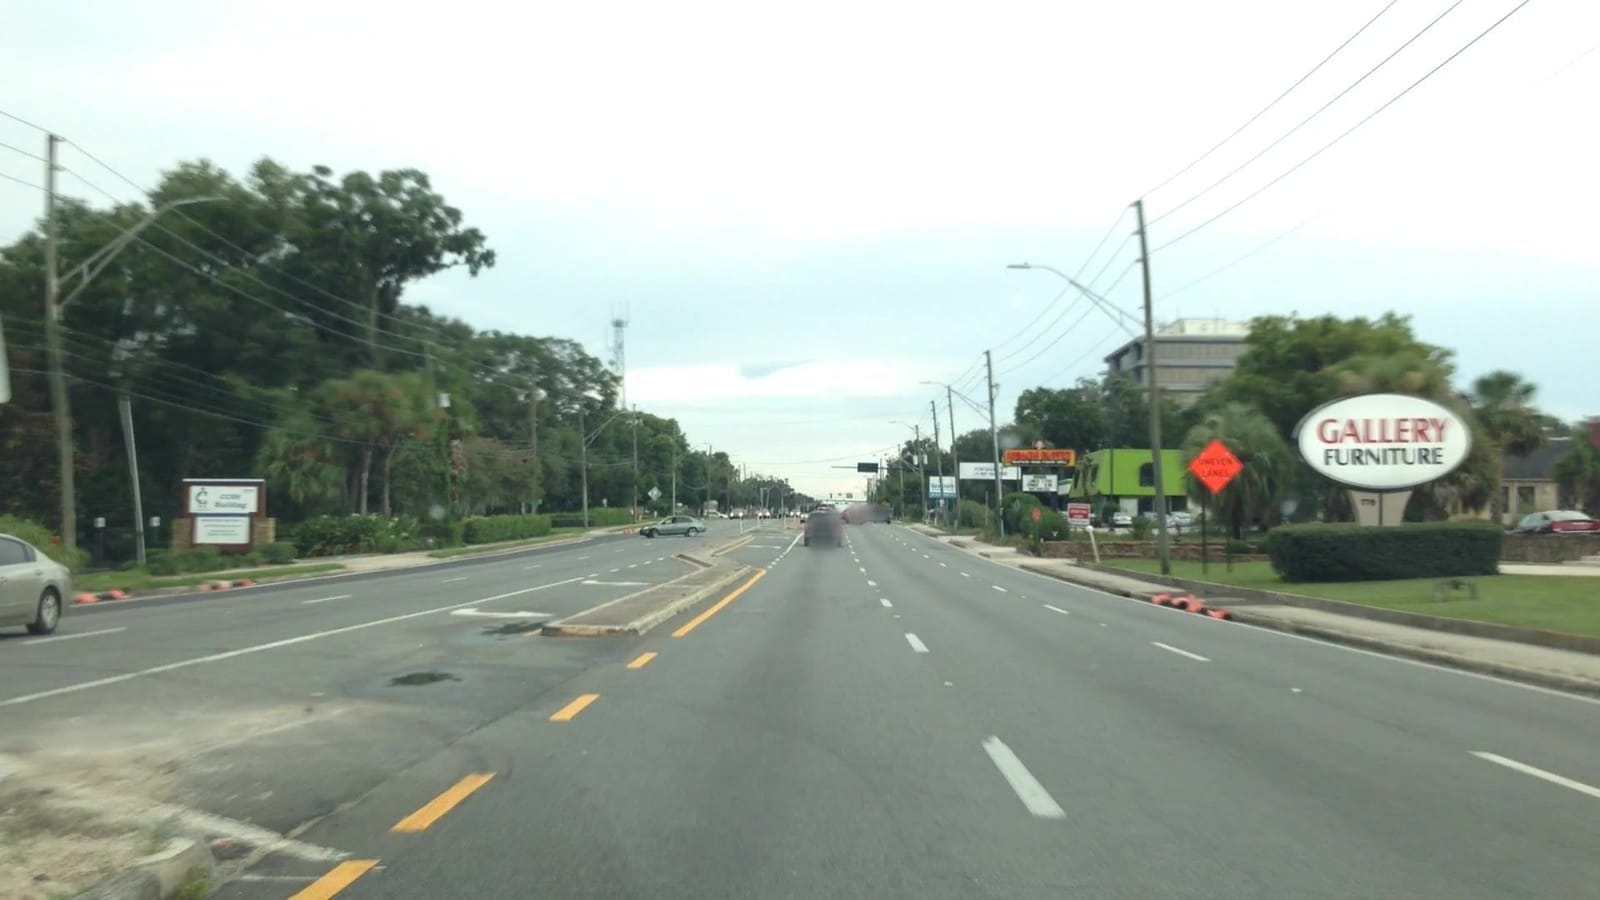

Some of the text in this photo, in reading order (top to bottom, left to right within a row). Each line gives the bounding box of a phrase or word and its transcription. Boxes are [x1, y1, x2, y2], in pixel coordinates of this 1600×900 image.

[1317, 418, 1448, 444] GALLERY
[1198, 457, 1233, 466] UNEVEN
[1324, 448, 1444, 466] FURNITURE
[1202, 469, 1230, 478] LANES
